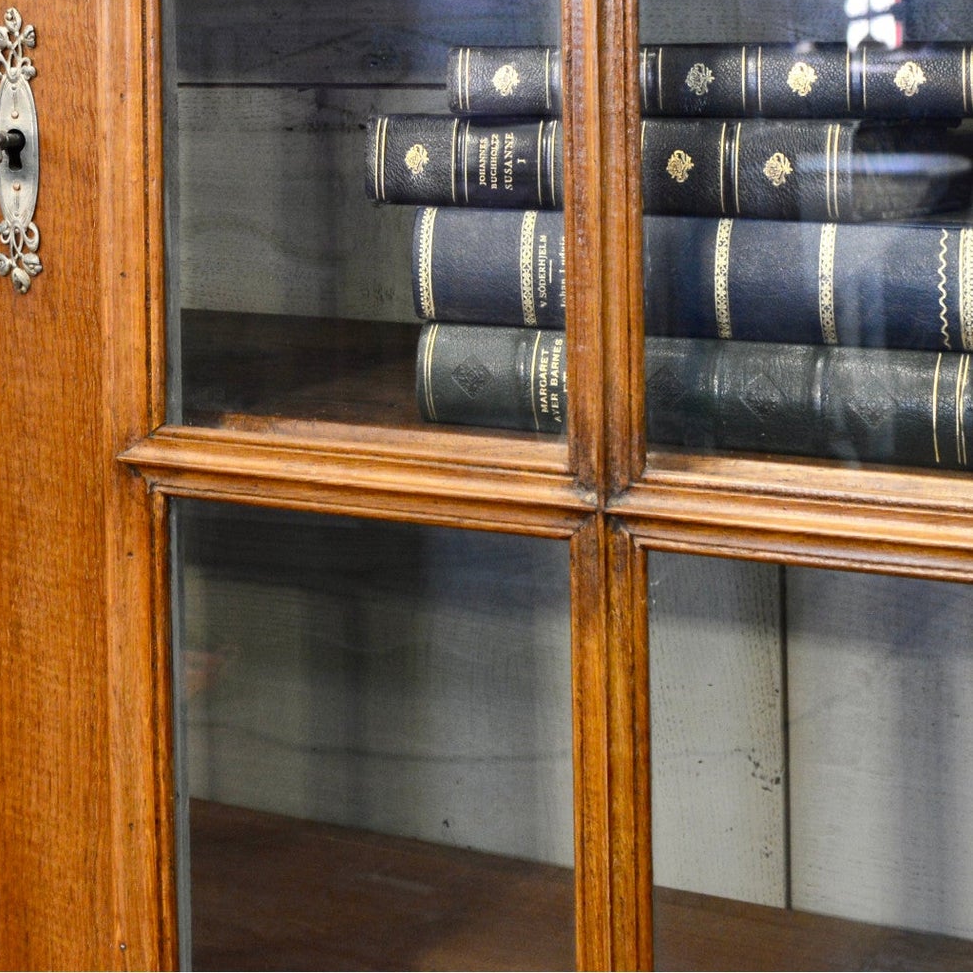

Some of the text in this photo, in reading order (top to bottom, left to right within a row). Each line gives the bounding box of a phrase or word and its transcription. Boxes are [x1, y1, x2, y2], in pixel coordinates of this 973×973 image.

[479, 137, 488, 186] JOHANNES
[490, 133, 499, 190] BUCHHOLTZ
[504, 132, 513, 191] SUSANNE
[537, 235, 548, 298] SÖDERHJELM
[539, 348, 549, 414] MARGARET
[550, 338, 563, 423] AYER BARNES
